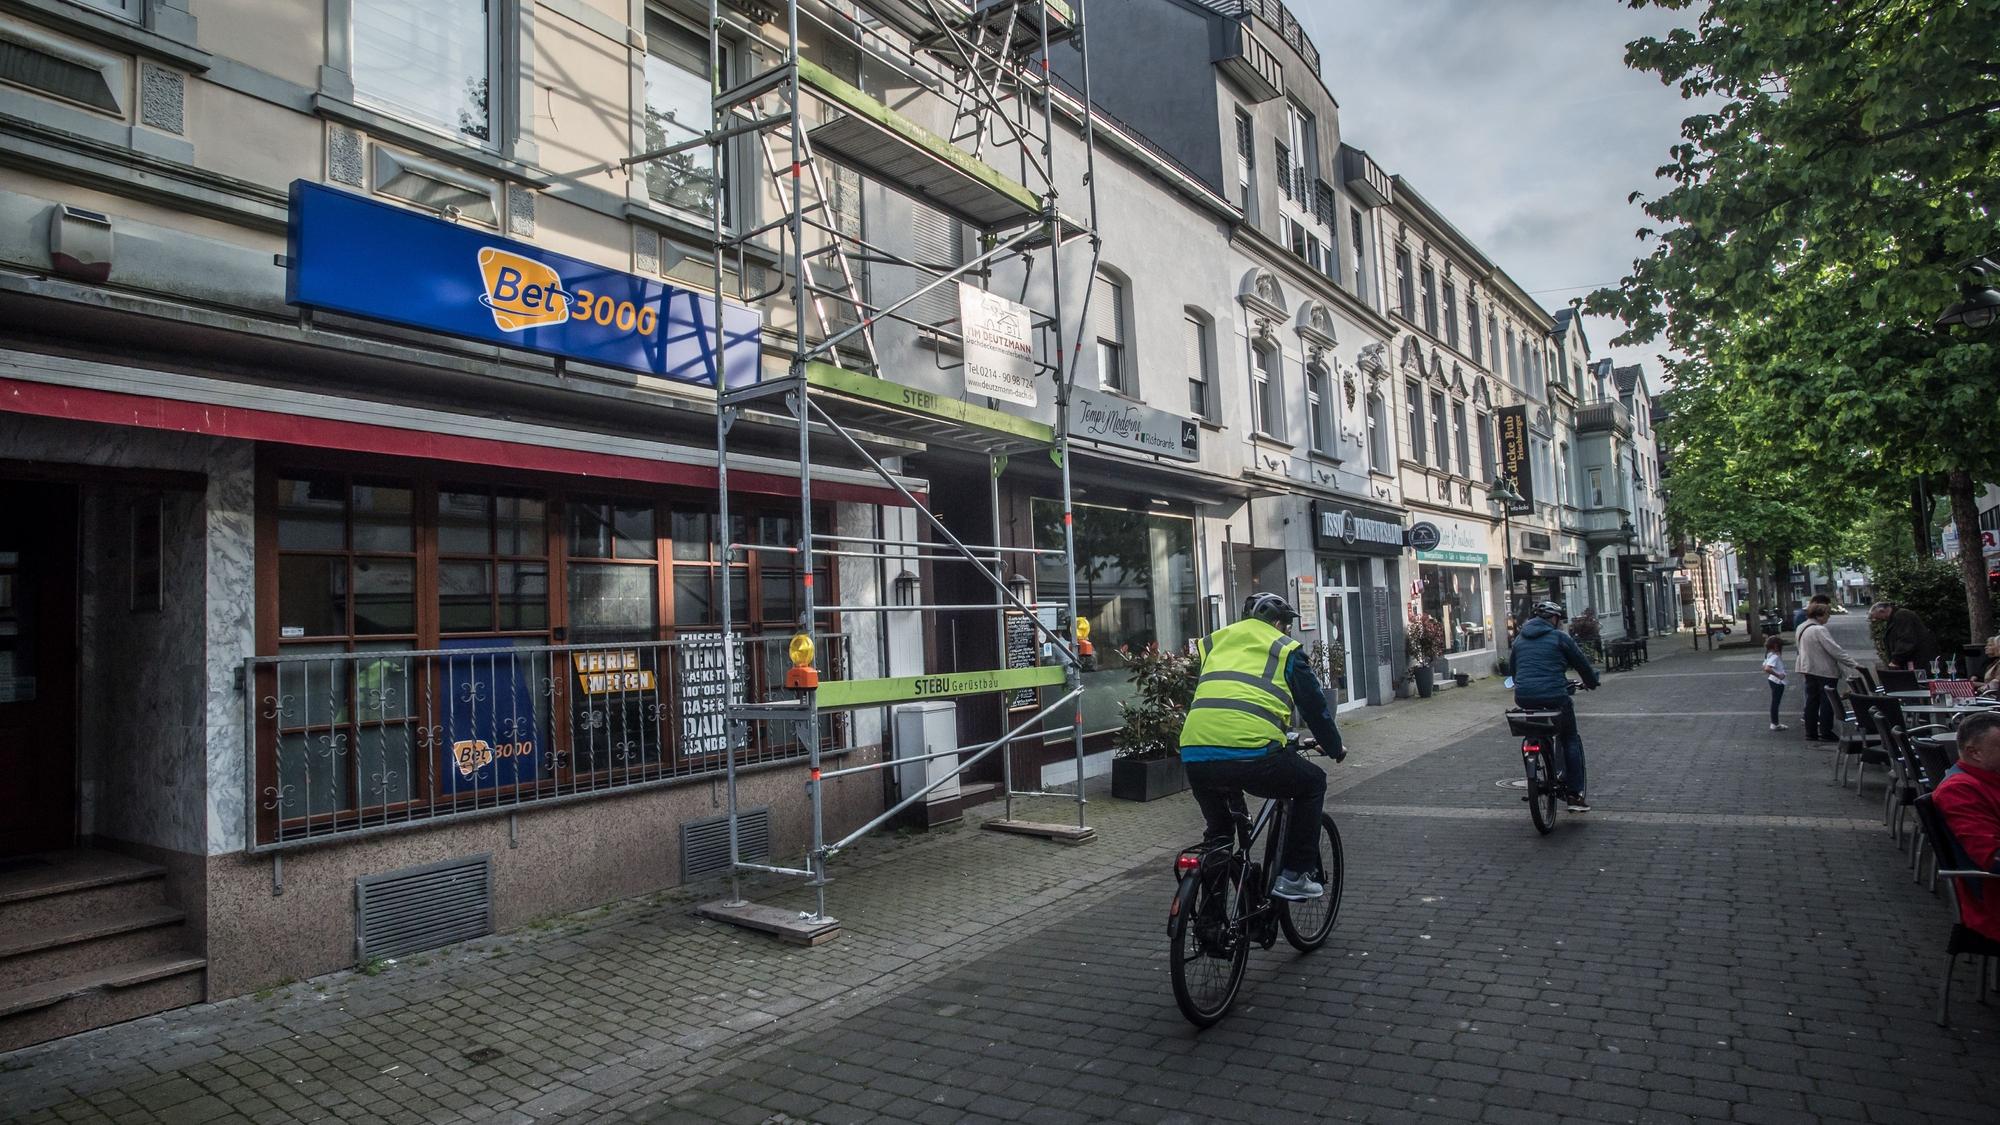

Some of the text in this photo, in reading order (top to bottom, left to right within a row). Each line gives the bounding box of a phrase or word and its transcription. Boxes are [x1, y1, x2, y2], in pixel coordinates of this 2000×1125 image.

[493, 266, 657, 336] Bet 3000
[967, 327, 1031, 354] TIM DEUTZMANN
[1080, 400, 1142, 438] Tempi Moderni
[1504, 415, 1515, 439] Bub
[1146, 433, 1175, 449] Ristorante
[1506, 440, 1518, 472] dicke
[579, 653, 636, 671] PFERDE
[683, 648, 745, 669] TENNS
[589, 672, 649, 692] WETTEN
[915, 678, 998, 695] STEBU Gerüstbau
[460, 741, 532, 762] Bet 3000
